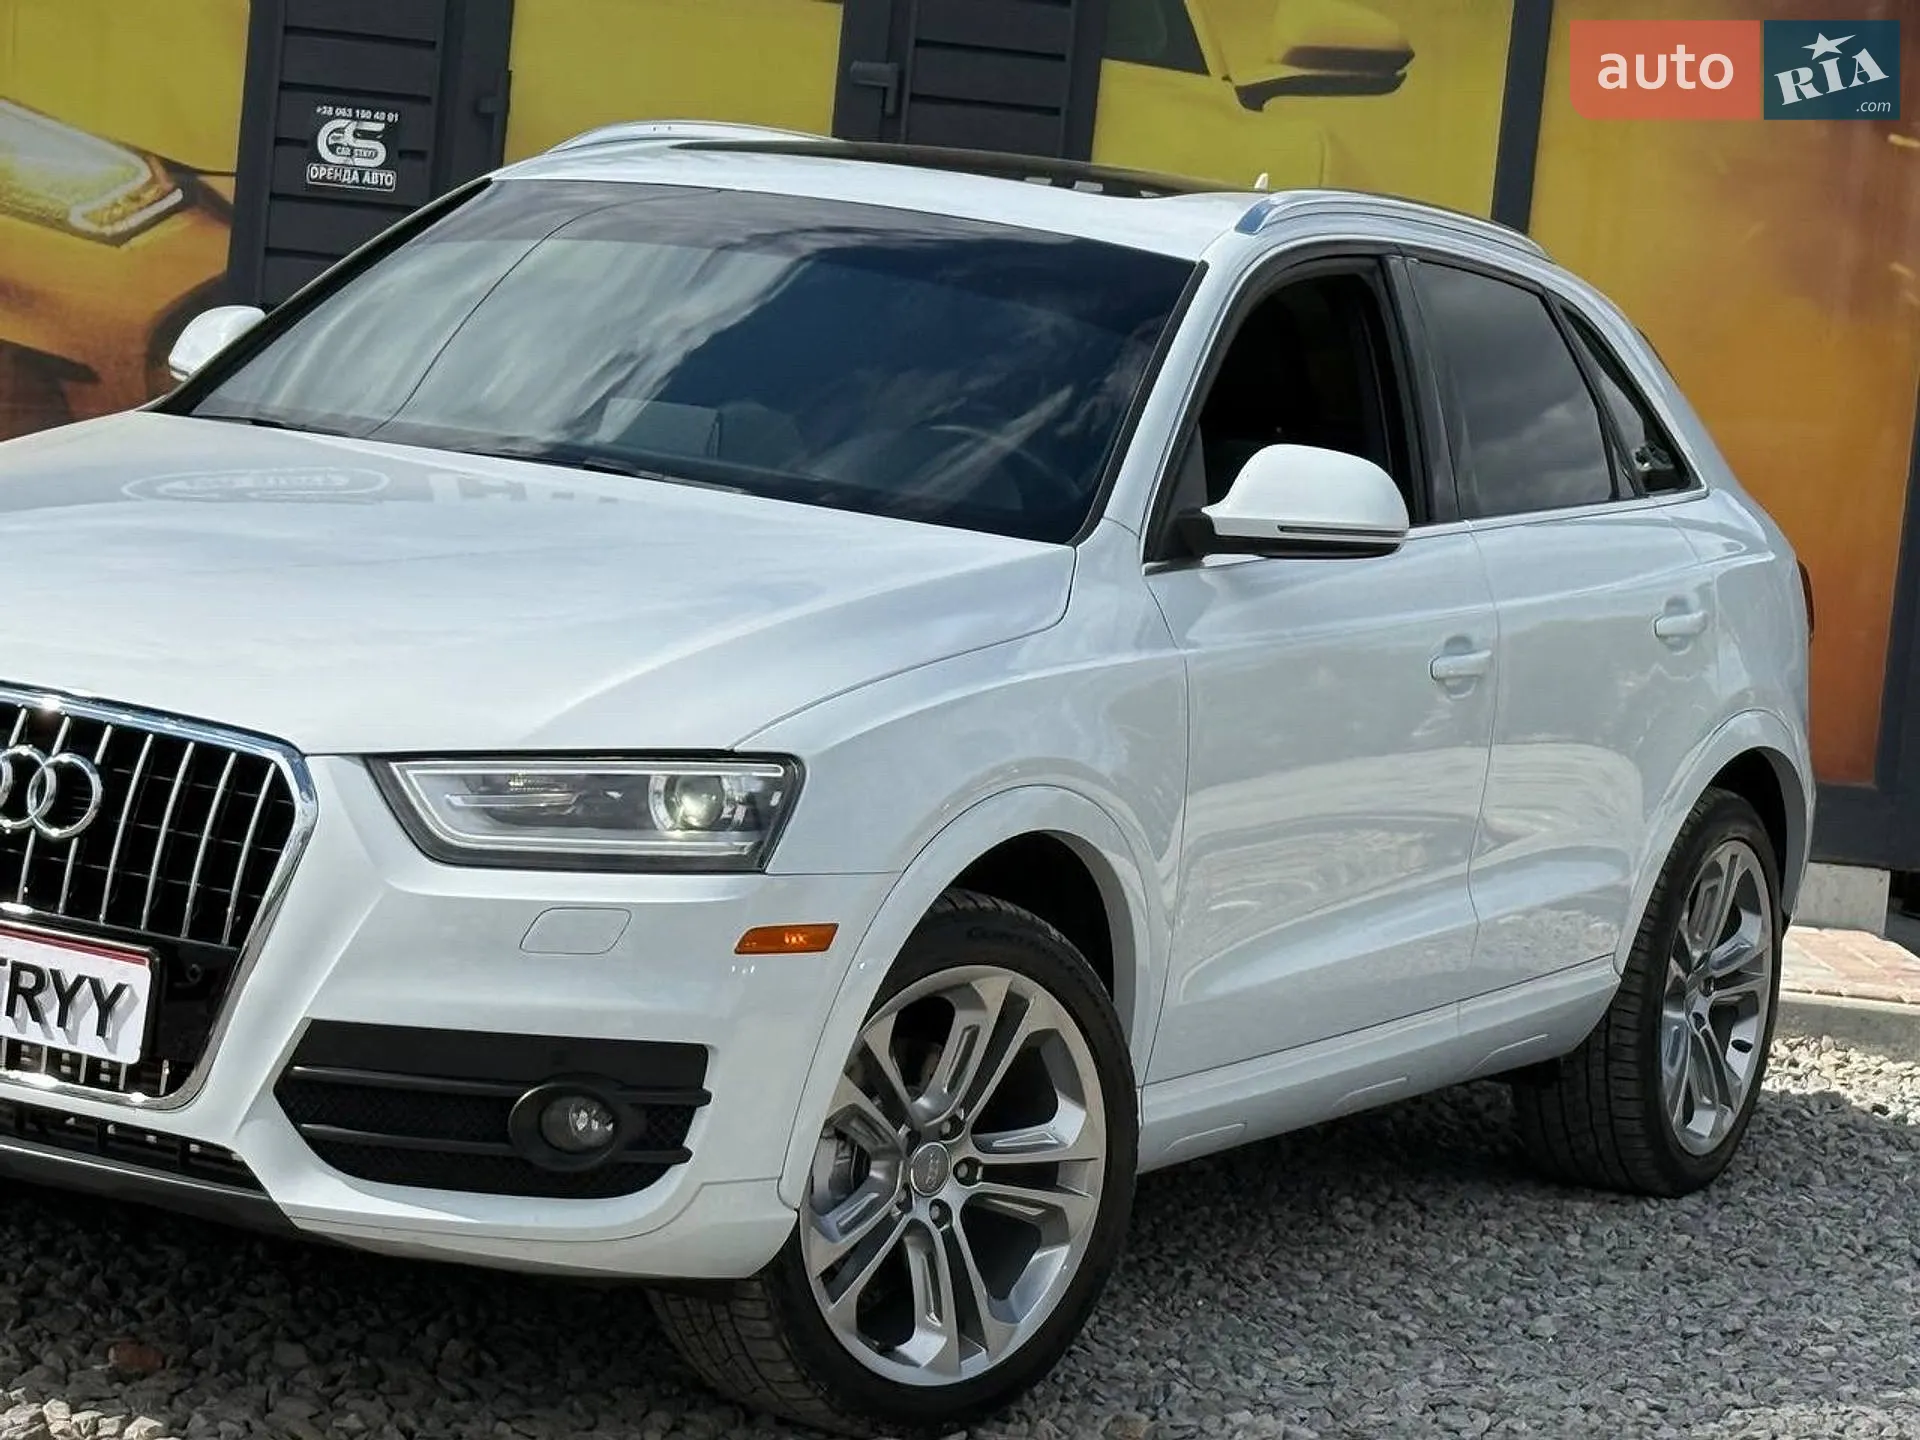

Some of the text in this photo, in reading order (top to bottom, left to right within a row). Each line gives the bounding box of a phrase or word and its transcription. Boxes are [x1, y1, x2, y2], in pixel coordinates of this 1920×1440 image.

[310, 166, 393, 186] ОРЕНДА АВТО
[0, 957, 129, 1038] RYY
